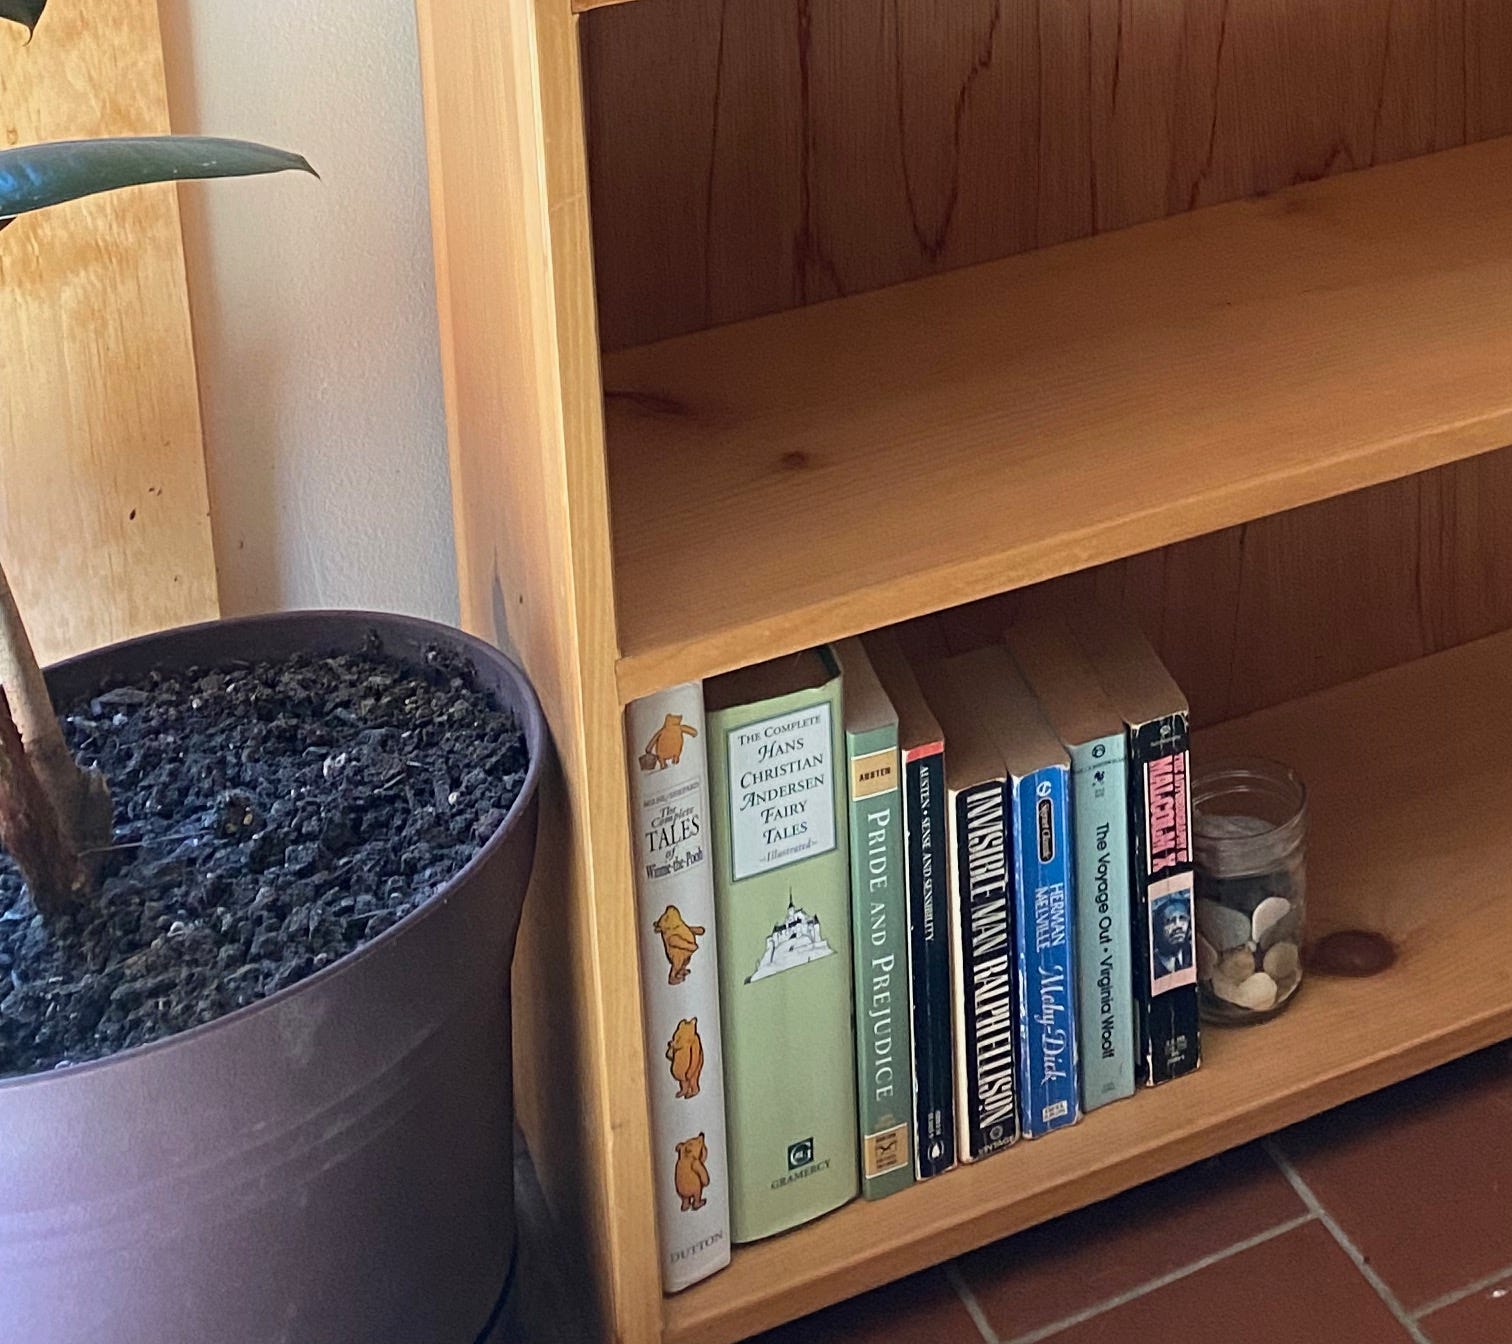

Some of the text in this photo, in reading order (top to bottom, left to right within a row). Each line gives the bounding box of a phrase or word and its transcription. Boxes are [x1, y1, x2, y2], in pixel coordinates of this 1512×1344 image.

[763, 820, 808, 846] TALES
[1094, 822, 1113, 944] The Voyage Out
[966, 788, 1013, 1128] INVISIBLE MAN RALPH ELLISON
[1036, 965, 1067, 1086] Moby-Dick
